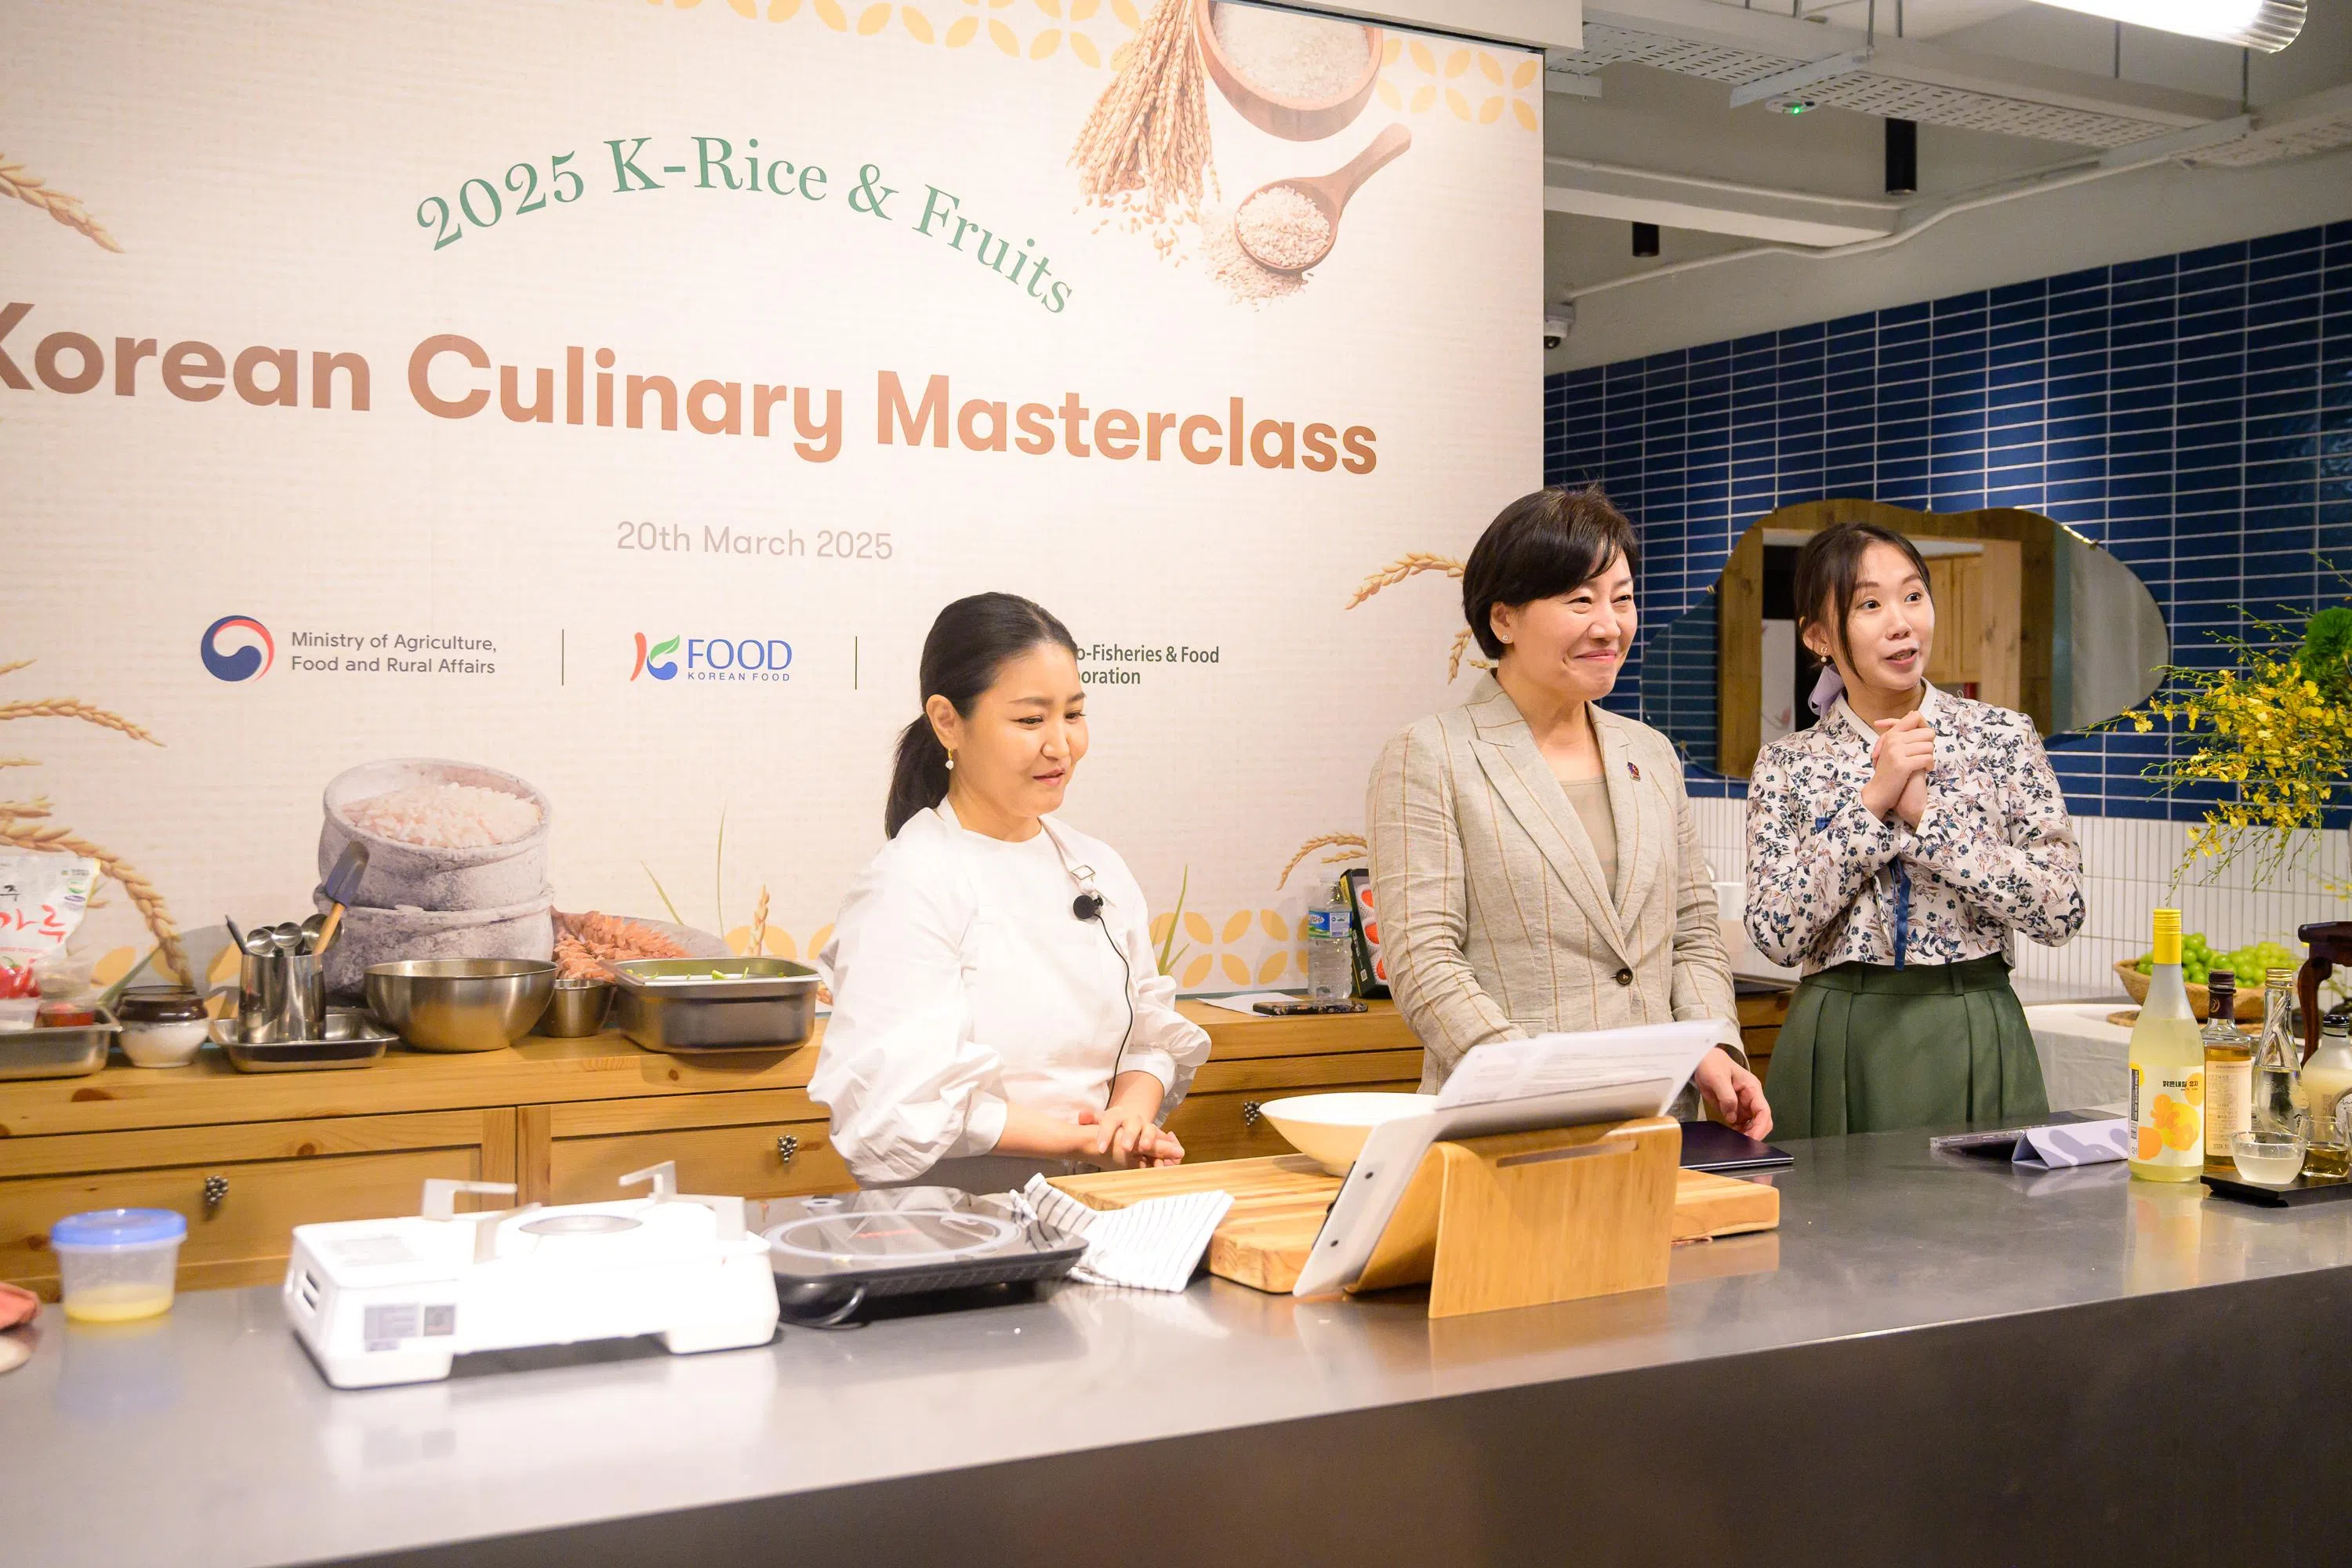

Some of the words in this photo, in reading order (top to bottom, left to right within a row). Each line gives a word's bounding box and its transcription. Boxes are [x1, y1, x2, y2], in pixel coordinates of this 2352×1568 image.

[417, 151, 583, 251] 2025
[604, 137, 827, 201] K-Rice
[848, 164, 898, 220] &
[912, 184, 1073, 314] Fruits
[408, 334, 843, 463] Culinary
[877, 370, 1377, 475] Masterclass
[617, 521, 691, 552] 20th
[704, 524, 805, 557] March
[816, 529, 894, 560] 2025
[292, 631, 365, 651] Ministry
[369, 633, 389, 648] of
[394, 633, 497, 653] Agriculture,
[291, 655, 339, 672] Food
[345, 657, 381, 673] and
[387, 657, 433, 673] Rural
[437, 659, 496, 674] Affairs
[688, 639, 793, 670] FOOD
[1076, 644, 1163, 662] o-Fisheries
[1165, 646, 1178, 662] &
[1181, 646, 1220, 663] Food
[688, 672, 746, 681] KOREAN
[752, 673, 791, 681] FOOD
[1078, 667, 1142, 684] oration
